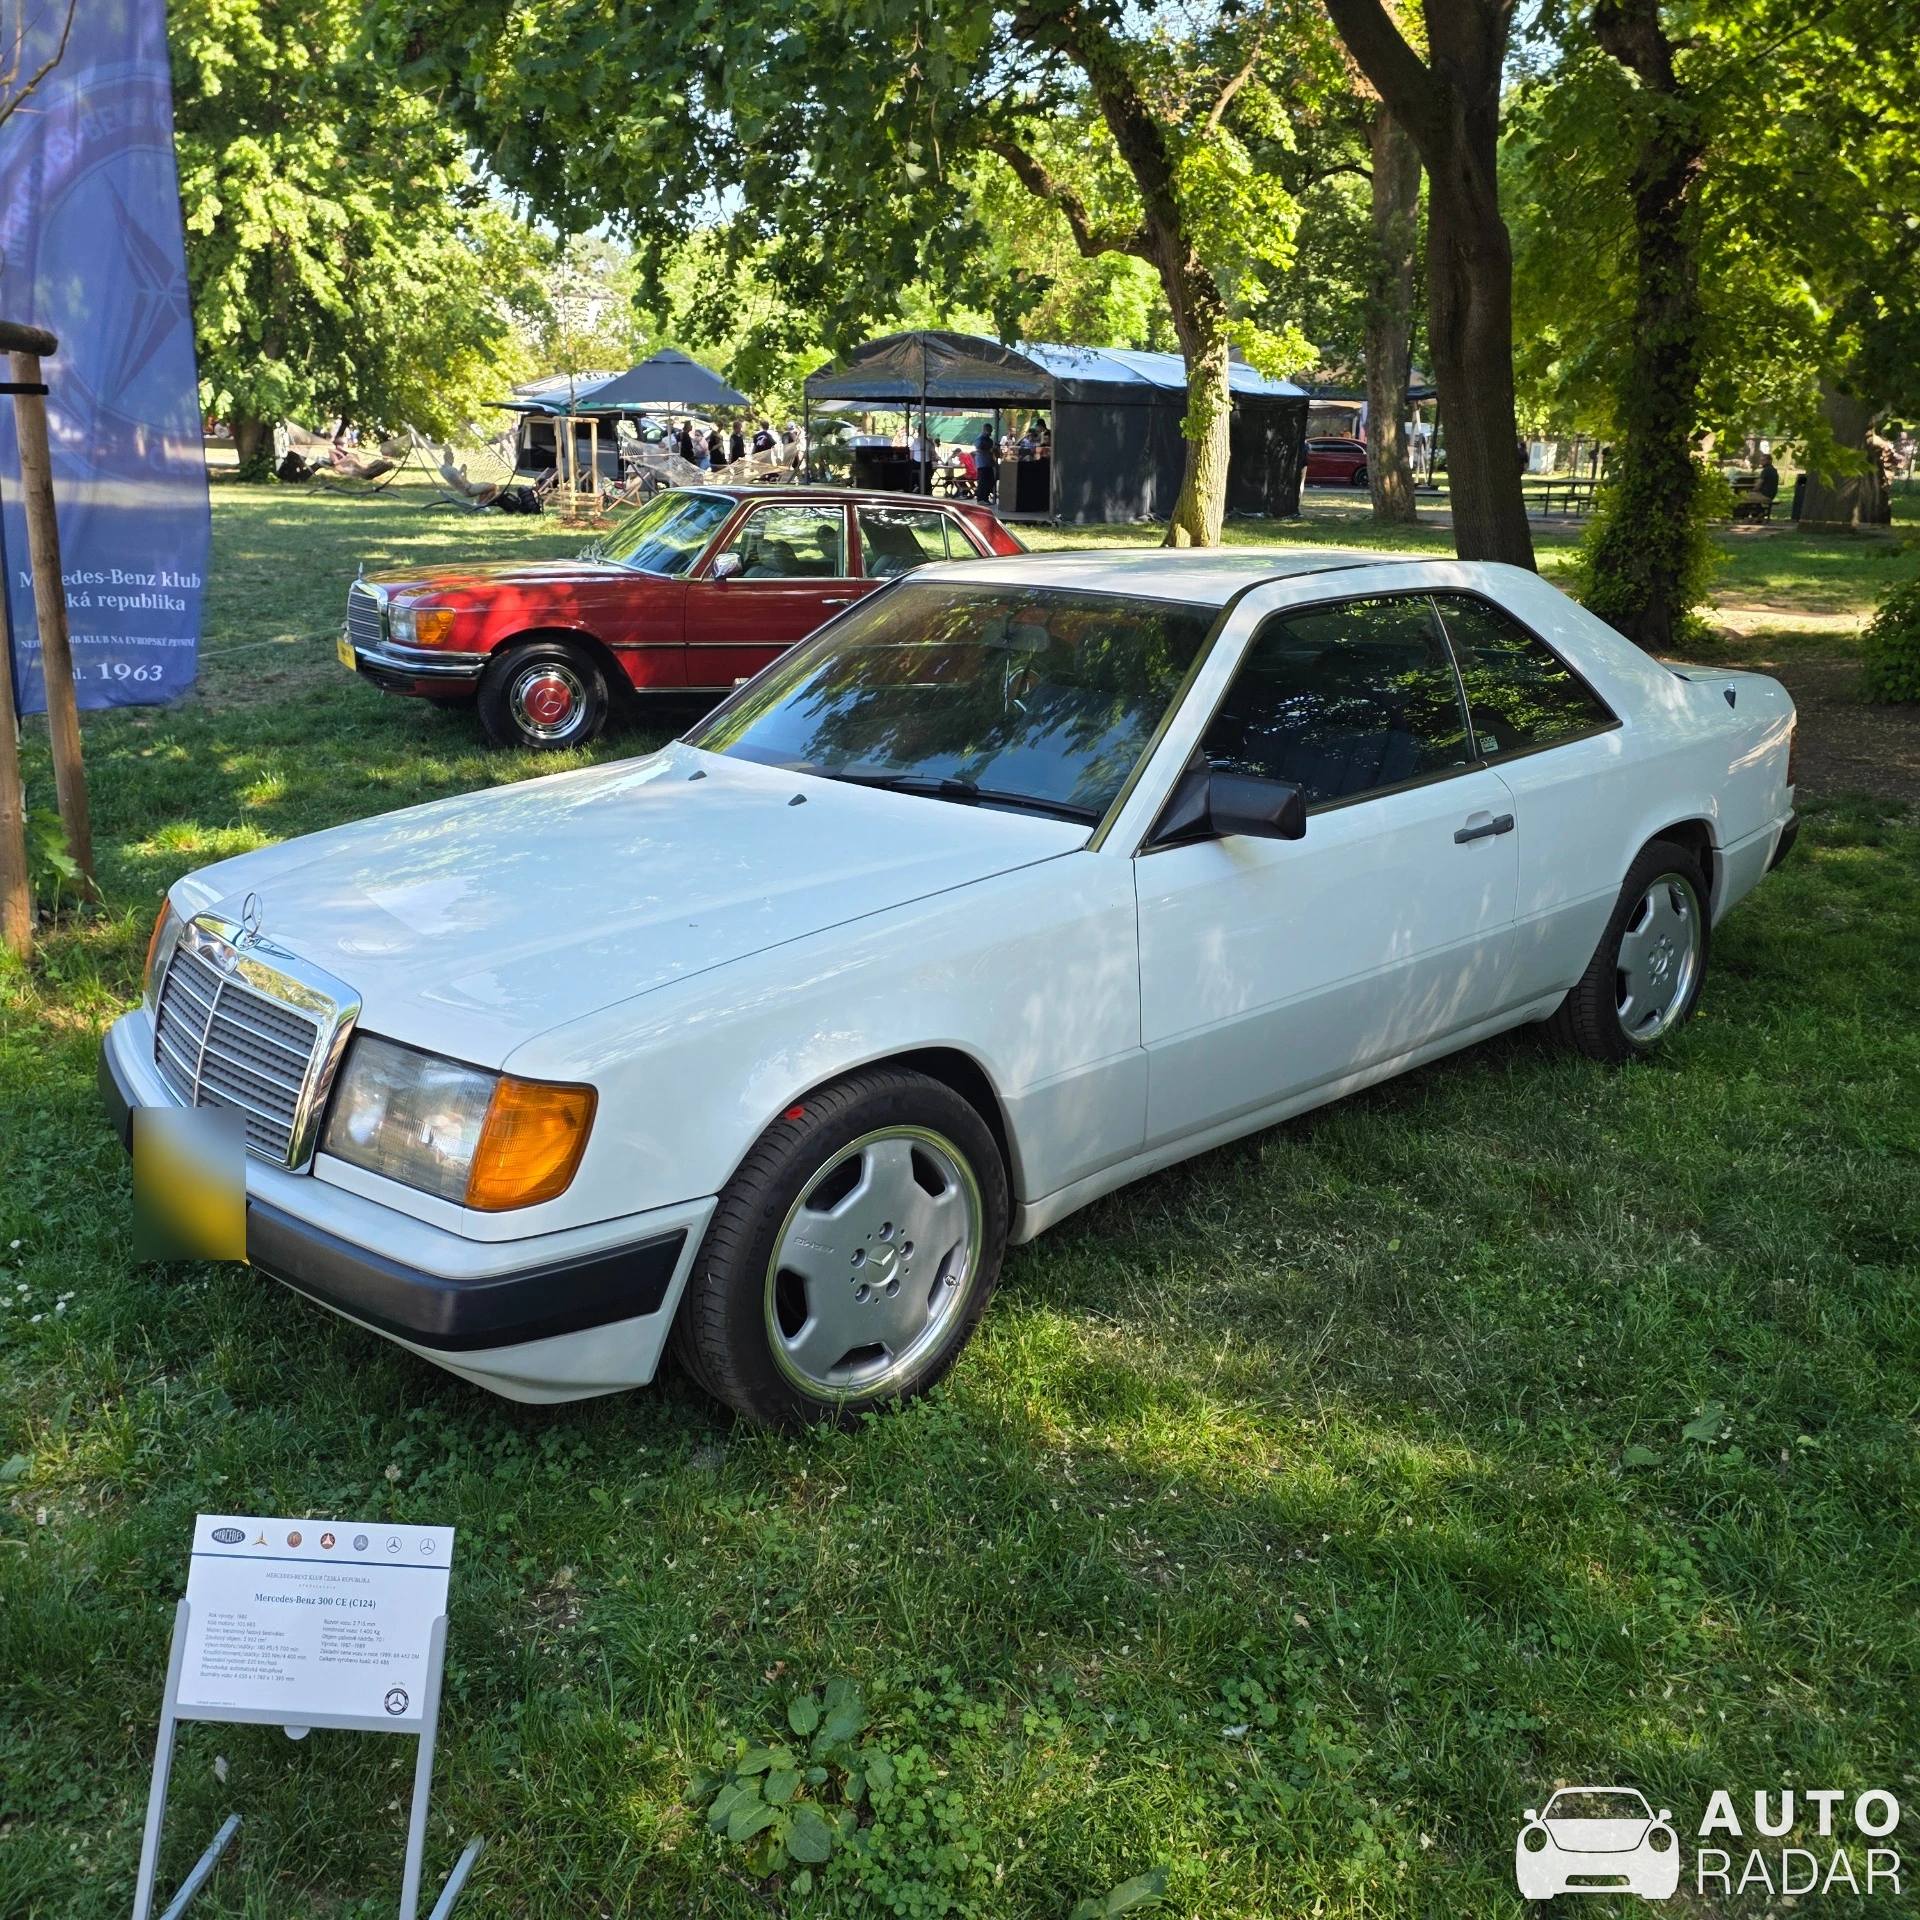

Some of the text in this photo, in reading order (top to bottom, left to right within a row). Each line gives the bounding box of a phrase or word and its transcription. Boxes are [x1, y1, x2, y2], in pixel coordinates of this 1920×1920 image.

[19, 568, 201, 589] Medes-Benz klub
[97, 593, 186, 612] republika
[83, 635, 110, 644] KLUB
[111, 635, 124, 645] NA
[96, 662, 164, 682] 1963
[213, 1529, 244, 1543] MERCEDES
[265, 1572, 308, 1581] MERCEDES-BENZ
[341, 1576, 371, 1584] REPUBLIKA
[254, 1593, 377, 1610] Mercedes-Benz 300 CE (C124)
